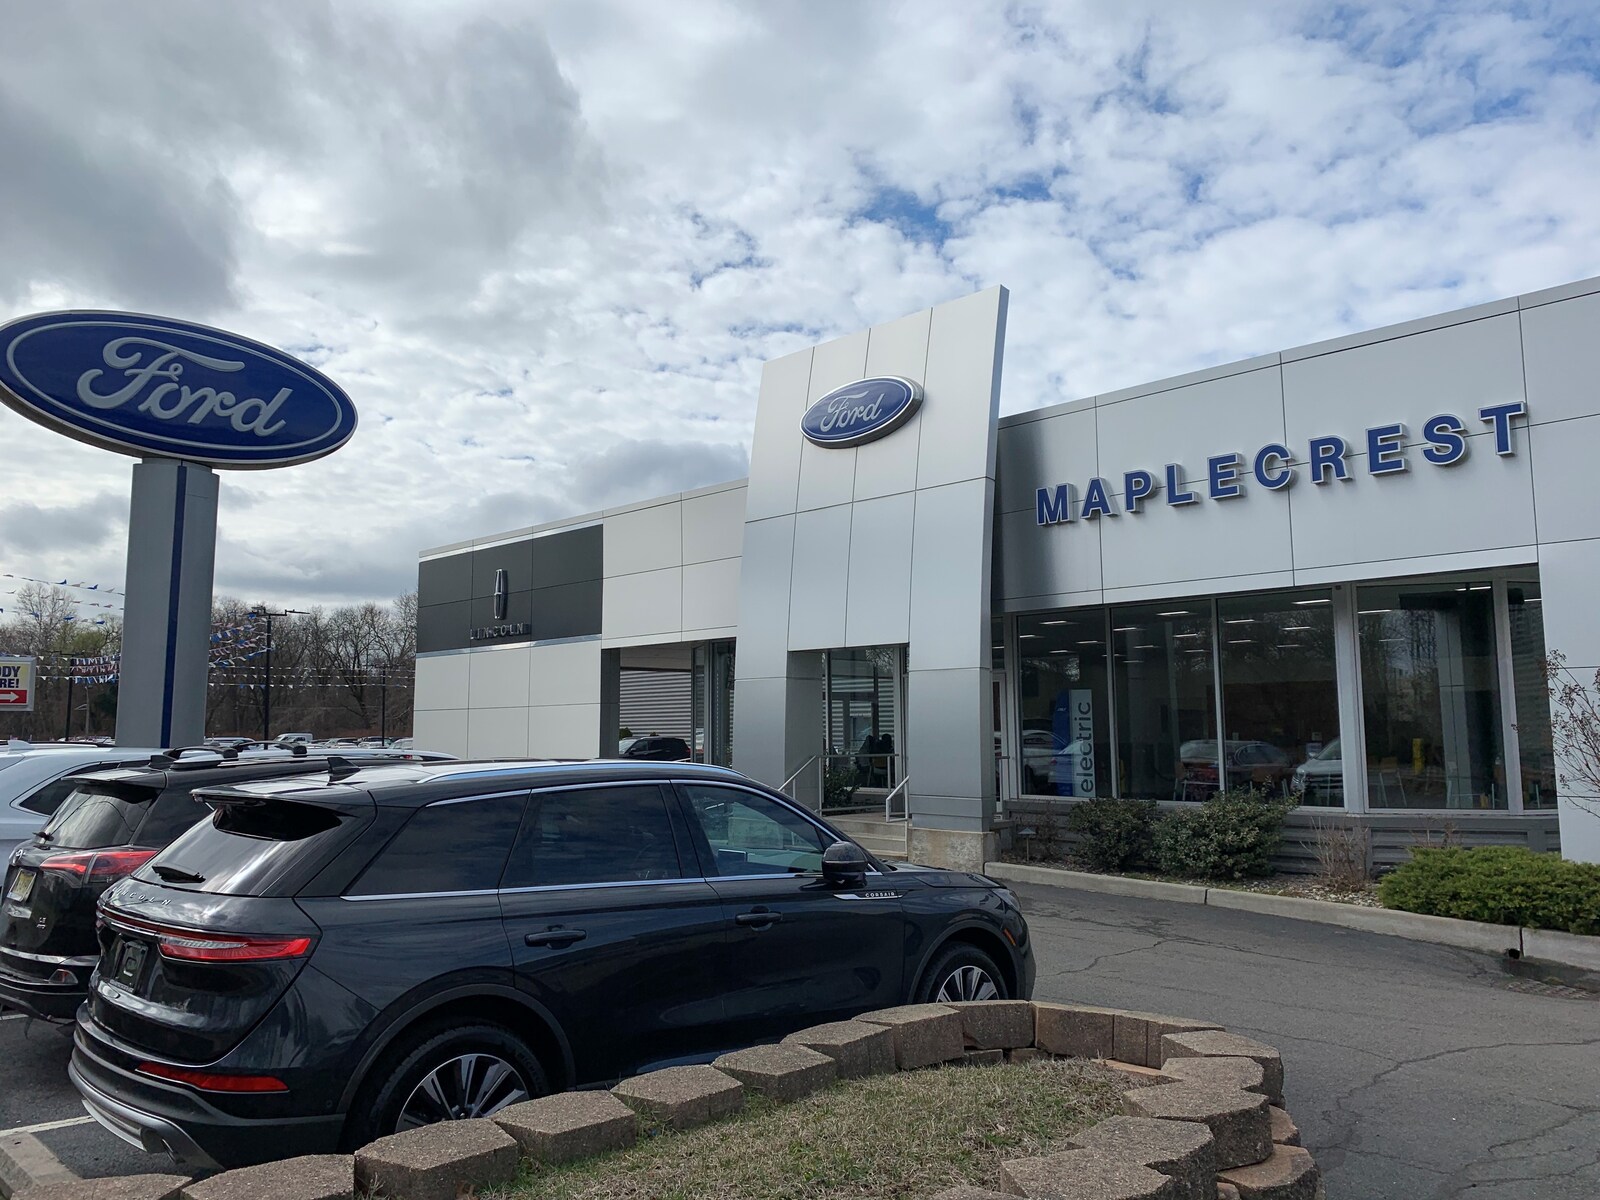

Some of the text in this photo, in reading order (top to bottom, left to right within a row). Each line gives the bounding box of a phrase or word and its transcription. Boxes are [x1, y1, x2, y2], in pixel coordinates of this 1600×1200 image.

[77, 336, 293, 437] Ford
[820, 390, 885, 432] Ford
[1036, 401, 1526, 526] MAPLECREST
[470, 622, 524, 640] LINCOLN
[0, 665, 21, 678] DY
[1074, 702, 1094, 793] electric
